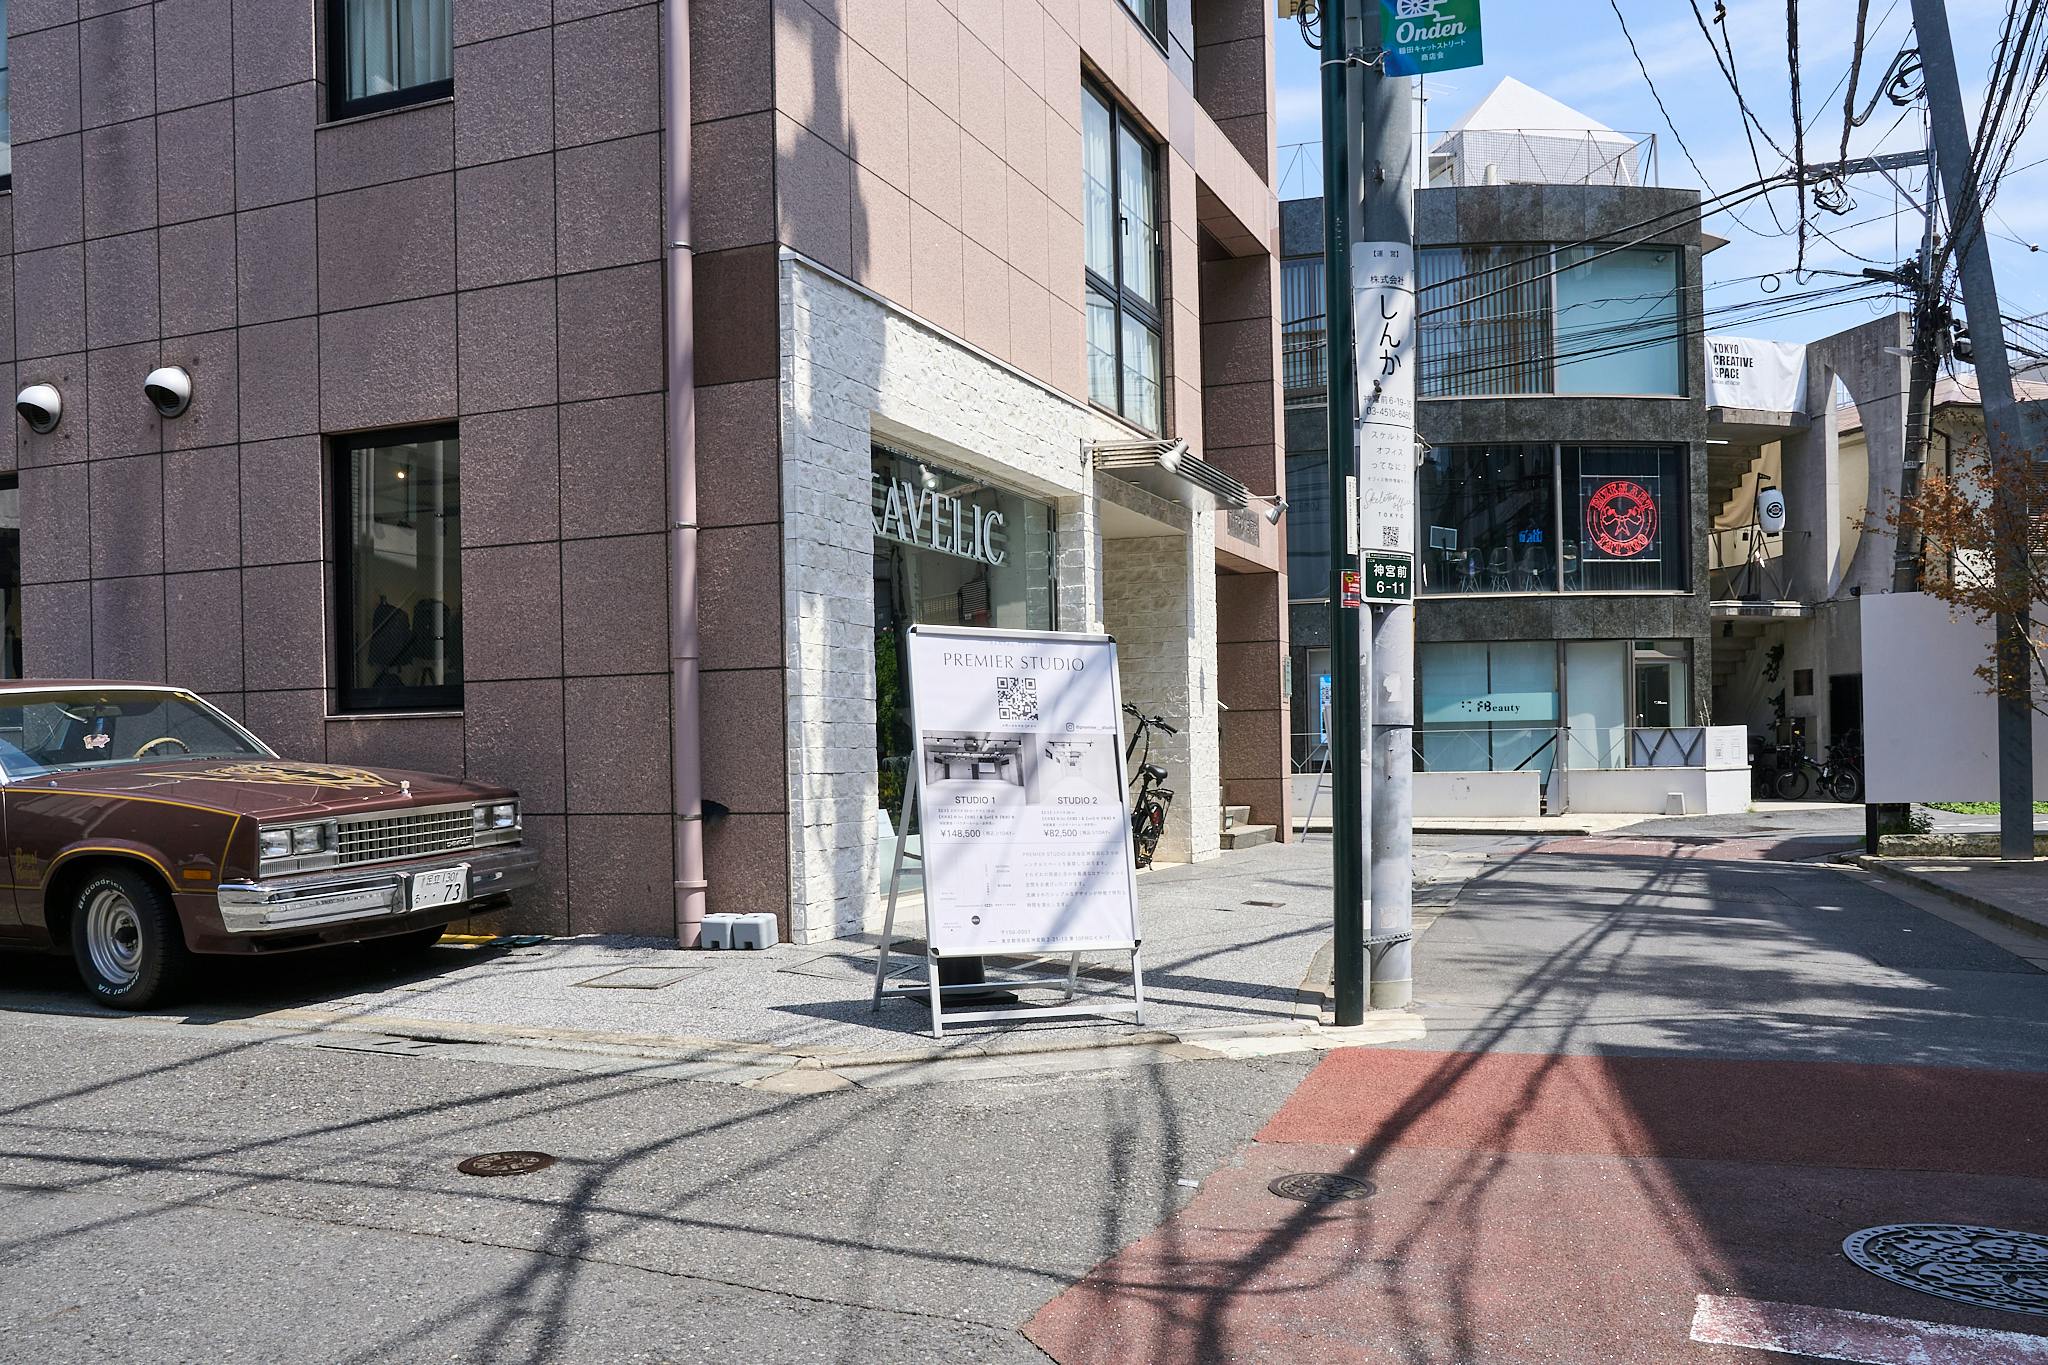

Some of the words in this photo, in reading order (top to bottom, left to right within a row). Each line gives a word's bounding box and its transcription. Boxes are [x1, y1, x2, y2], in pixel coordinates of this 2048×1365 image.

[1396, 22, 1467, 44] Onden
[1370, 275, 1404, 285] 株式会社
[1713, 343, 1739, 355] TOKYO
[1713, 355, 1754, 368] CREATIVE
[1714, 367, 1740, 379] SPACE
[1376, 447, 1404, 456] オフィス
[1373, 563, 1408, 579] 神宮前
[1376, 580, 1405, 595] 6-11
[943, 652, 1014, 670] PREMIER
[1020, 655, 1085, 672] STUDIO
[955, 795, 989, 804] STUDIO
[991, 796, 996, 804] 1
[1057, 796, 1090, 805] STUDIO
[1092, 796, 1098, 805] 2
